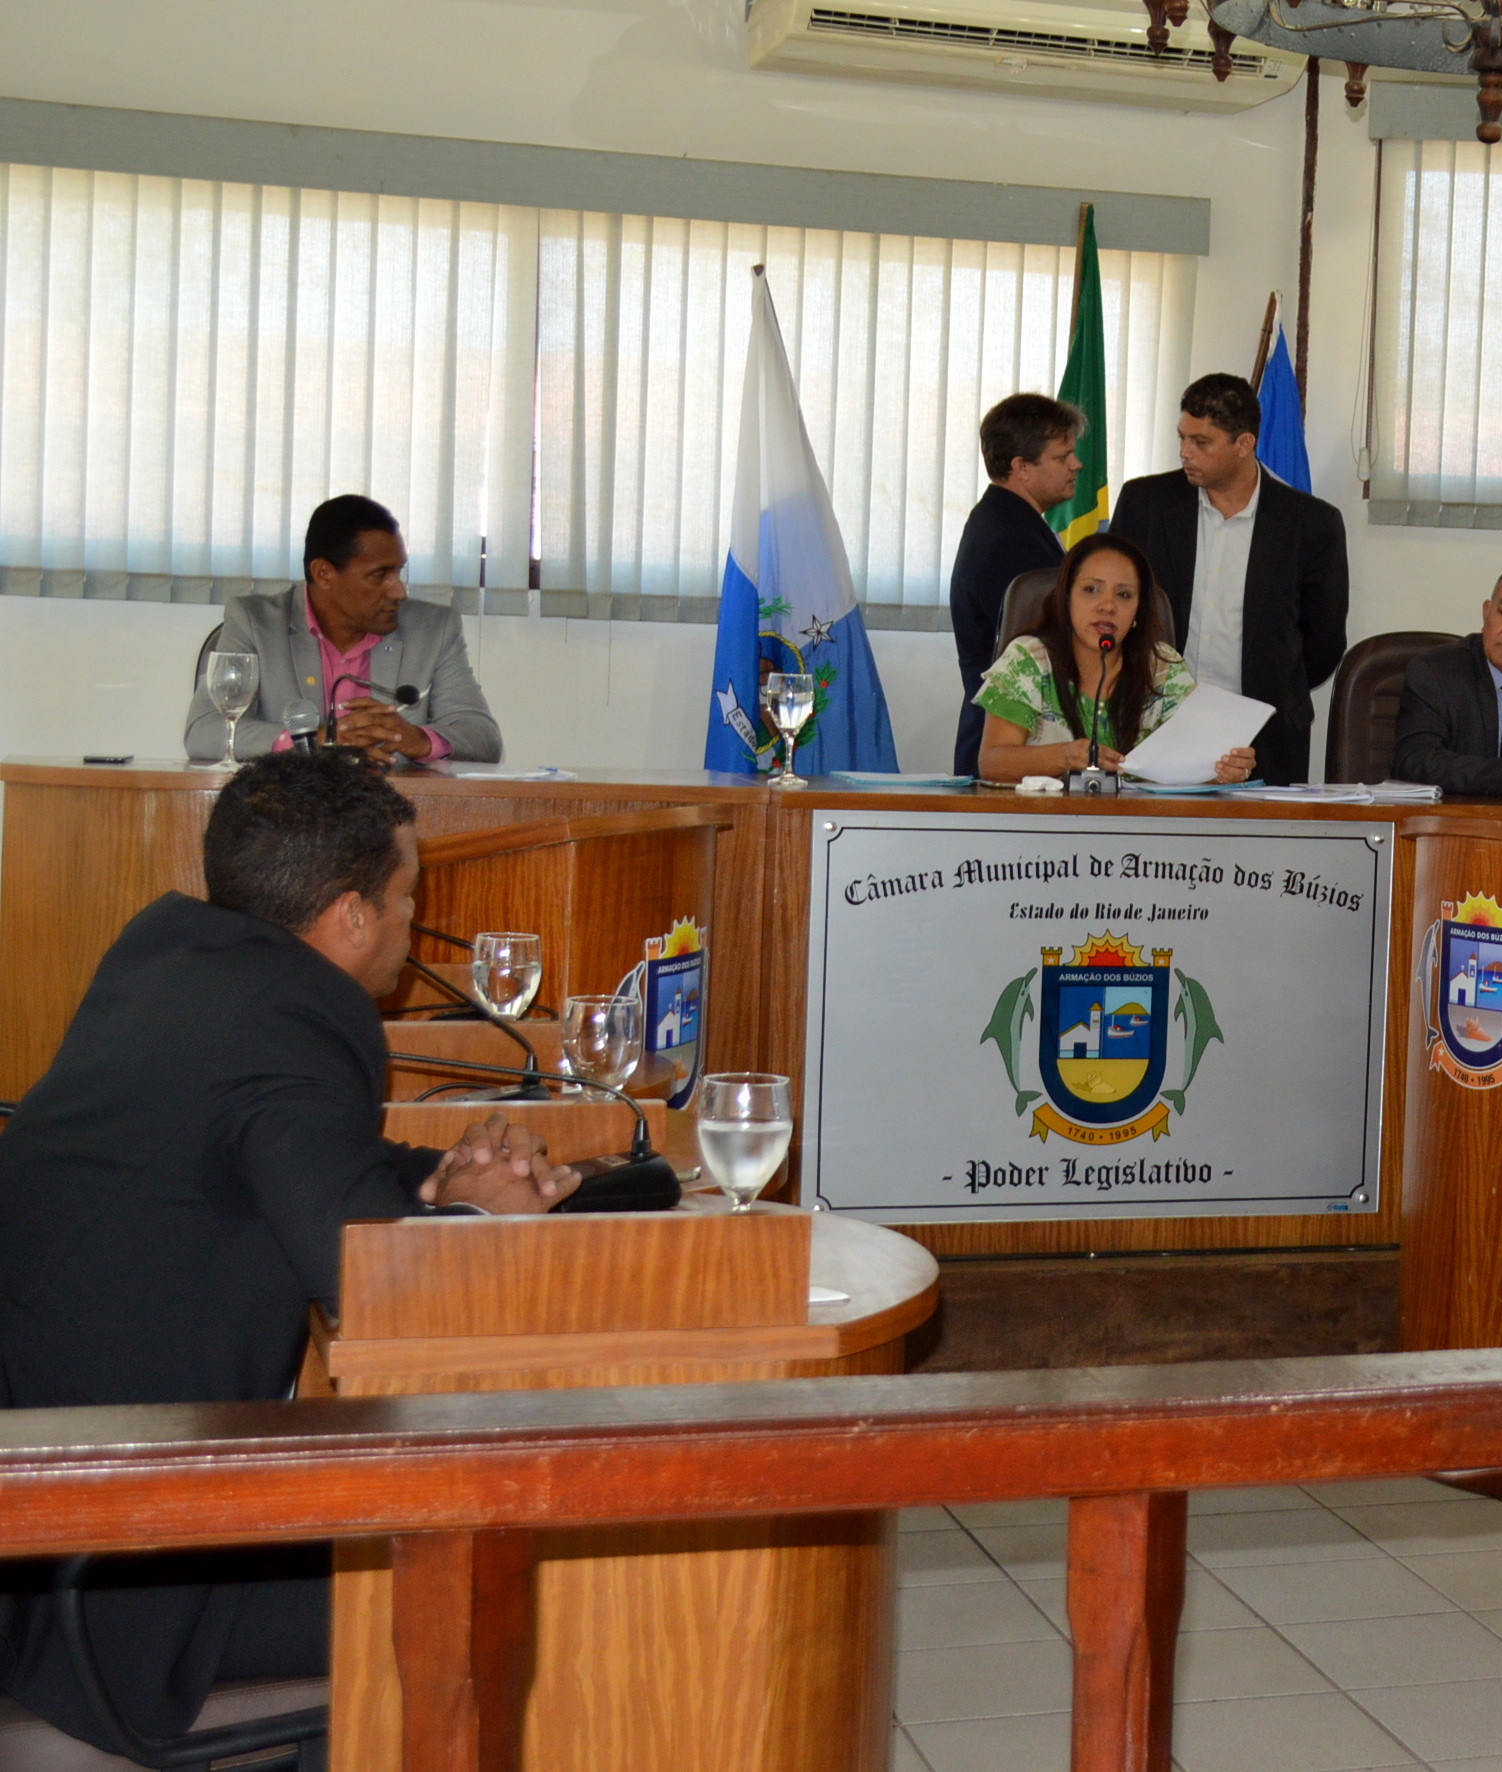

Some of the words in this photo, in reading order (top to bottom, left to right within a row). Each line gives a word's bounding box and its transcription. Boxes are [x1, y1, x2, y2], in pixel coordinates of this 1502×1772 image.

[844, 869, 944, 905] Câmara
[952, 854, 1080, 888] Municipal
[1089, 854, 1114, 877] de
[1119, 853, 1224, 890] Armação
[1233, 864, 1274, 890] dos
[1280, 869, 1364, 912] Búzios
[1009, 902, 1064, 919] Estado
[1069, 903, 1089, 919] do
[1147, 903, 1209, 922] Janeiro
[1450, 927, 1476, 939] ARMAÇÃO
[1476, 931, 1490, 940] DOS
[1059, 972, 1102, 982] ARMAÇÃO
[1103, 973, 1121, 981] DOS
[1123, 971, 1154, 981] BÚZIOS
[1453, 1068, 1469, 1083] 1740
[1477, 1074, 1496, 1086] 1995
[1067, 1126, 1095, 1141] 1740
[1109, 1125, 1137, 1140] 1995
[964, 1159, 1050, 1194] Poder
[1060, 1157, 1212, 1191] Legislativo
